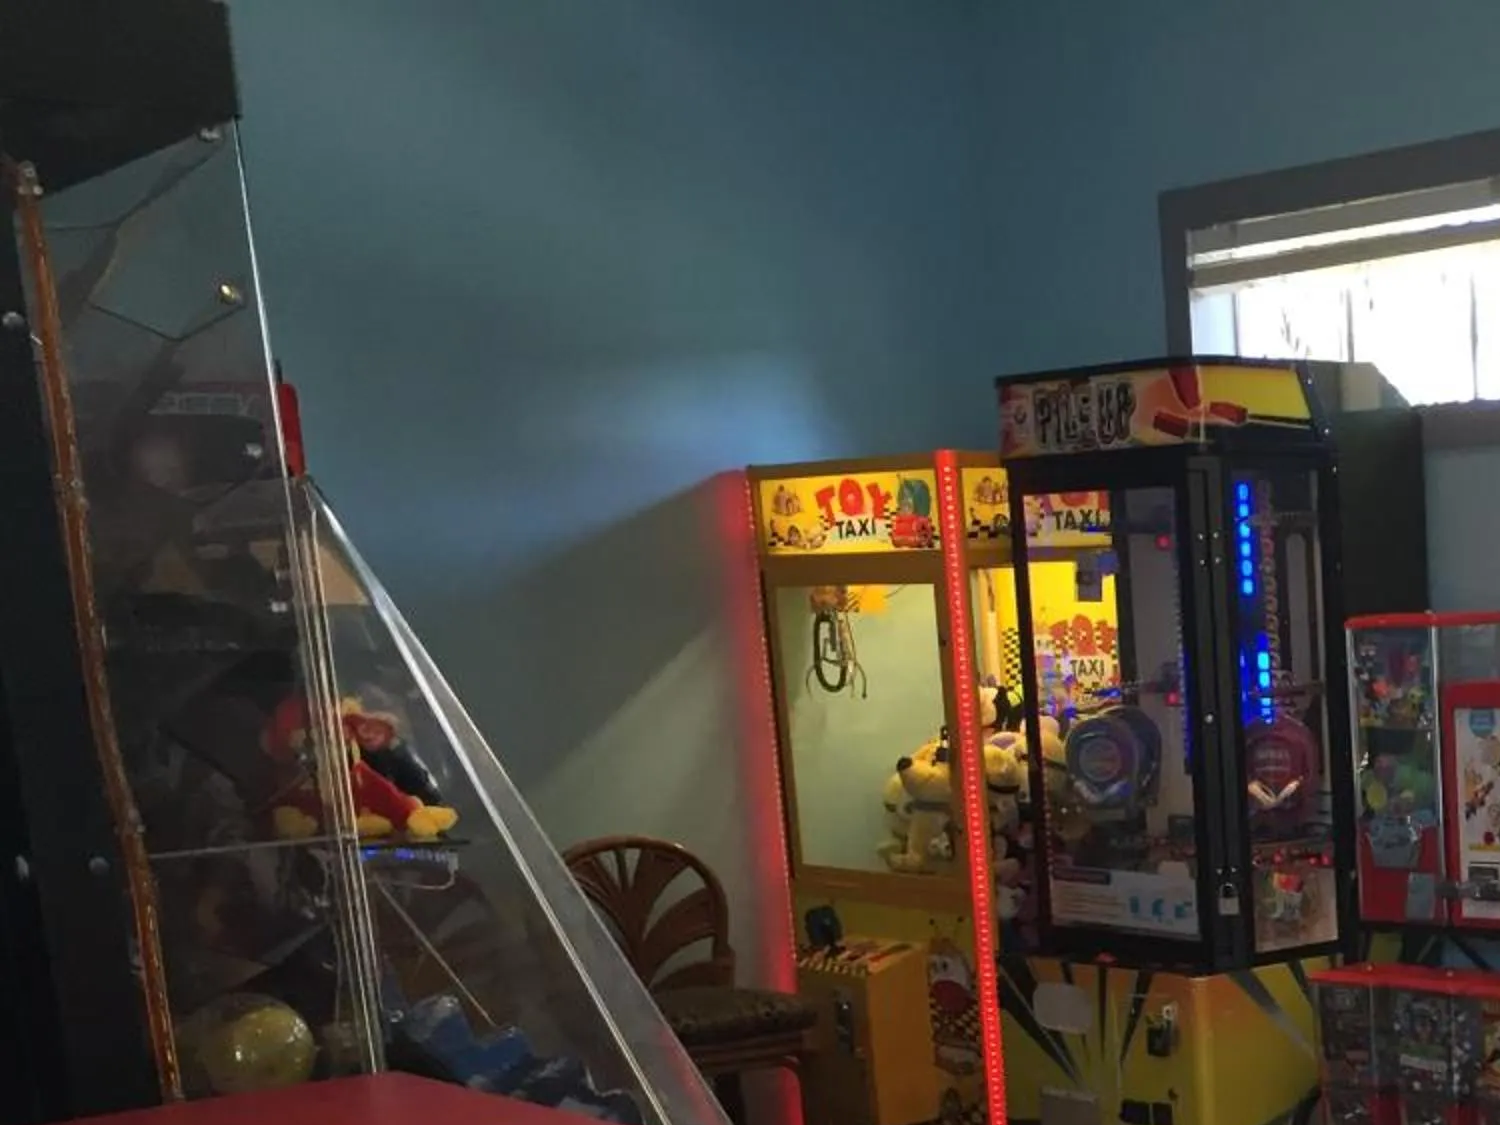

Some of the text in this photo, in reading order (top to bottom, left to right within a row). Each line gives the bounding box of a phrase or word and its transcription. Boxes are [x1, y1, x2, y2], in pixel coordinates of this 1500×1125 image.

[815, 478, 892, 527] TOY
[836, 518, 877, 540] TAXI
[1052, 508, 1102, 531] TAXI
[1069, 658, 1105, 678] TAXI
